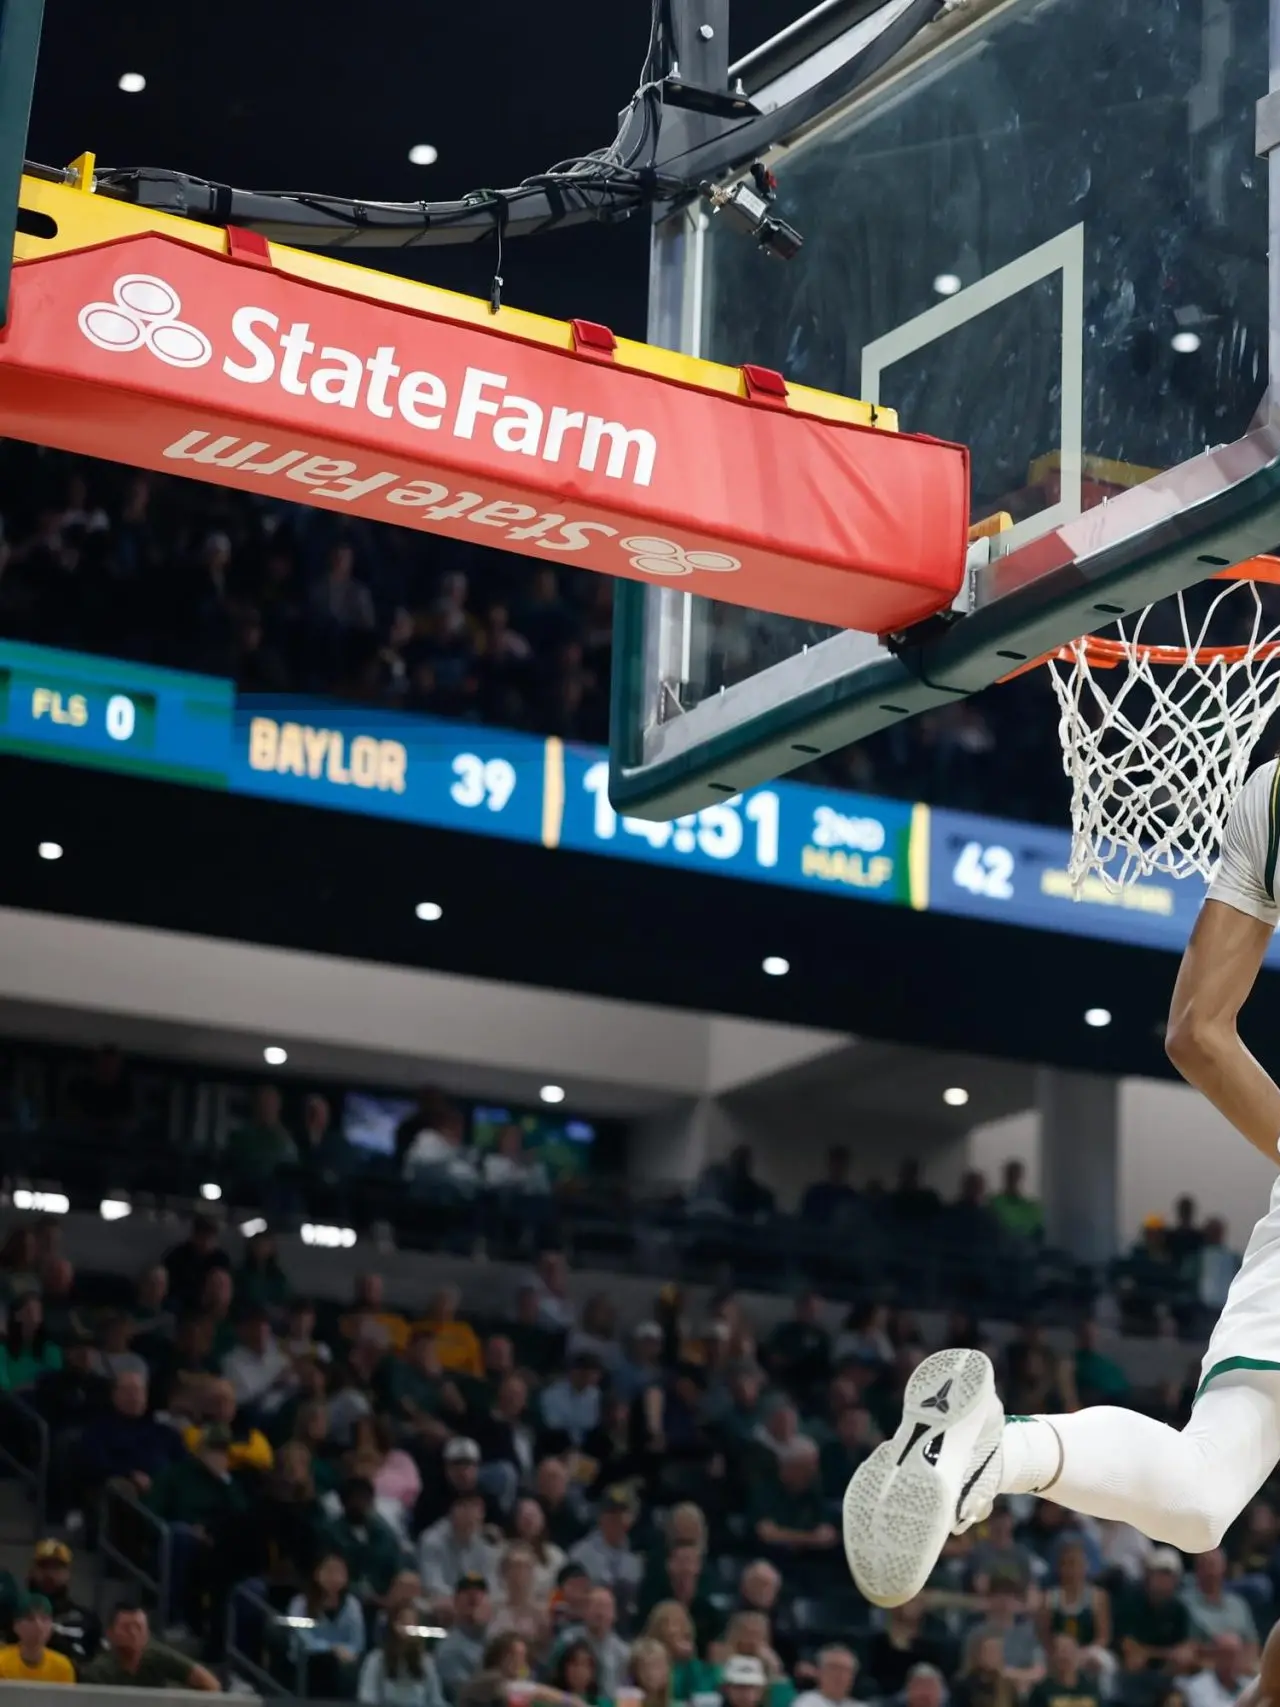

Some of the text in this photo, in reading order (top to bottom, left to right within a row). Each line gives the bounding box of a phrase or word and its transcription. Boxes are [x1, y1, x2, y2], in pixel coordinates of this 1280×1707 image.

[31, 688, 135, 741] FLS 0
[249, 717, 516, 812] BAYLOR 39
[953, 841, 1015, 900] 42
